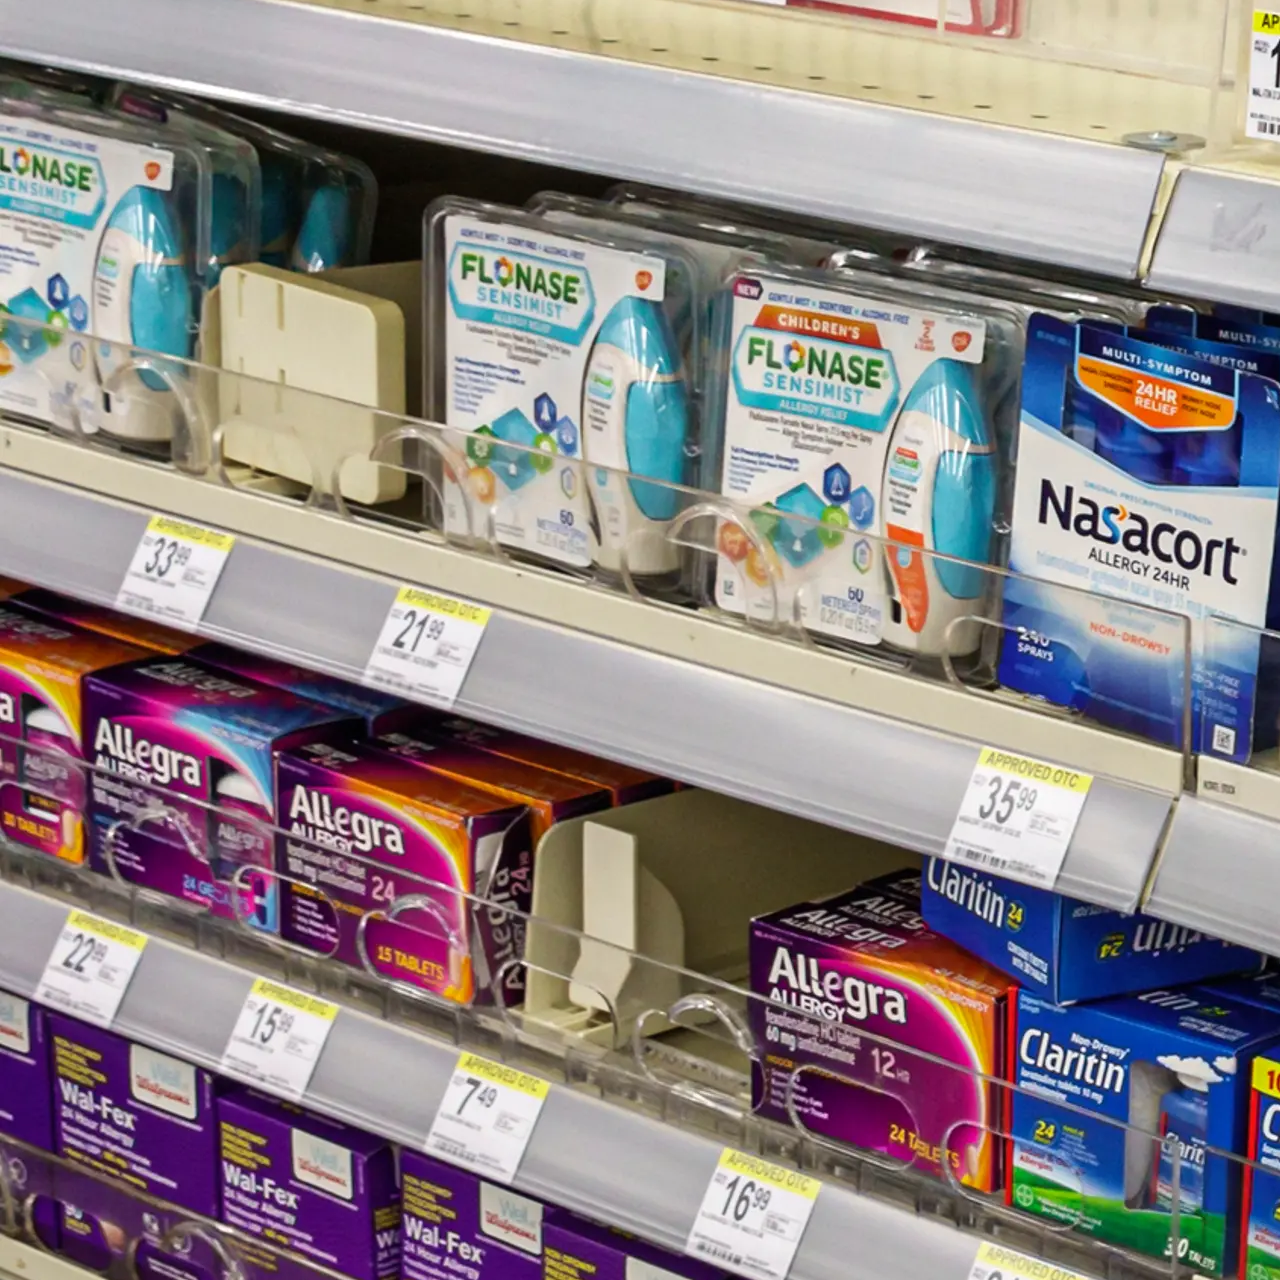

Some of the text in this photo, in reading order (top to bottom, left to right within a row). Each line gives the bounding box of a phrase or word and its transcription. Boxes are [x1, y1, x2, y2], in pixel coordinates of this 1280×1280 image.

[461, 253, 580, 303] FLONASE
[477, 286, 561, 317] SENSIMIST
[778, 312, 860, 339] CHILDREN'S
[749, 338, 883, 388] FLONASE
[1102, 345, 1211, 385] MULTI-SYMPTOM
[764, 373, 864, 405] SENSIMIST
[1135, 396, 1177, 417] RELIEF
[1039, 478, 1239, 584] Nasacort
[1088, 546, 1190, 591] ALLERGY 24HR
[1090, 622, 1170, 655] NON-DROWSY
[290, 785, 403, 855] Allegra
[768, 947, 906, 1022] Allegra
